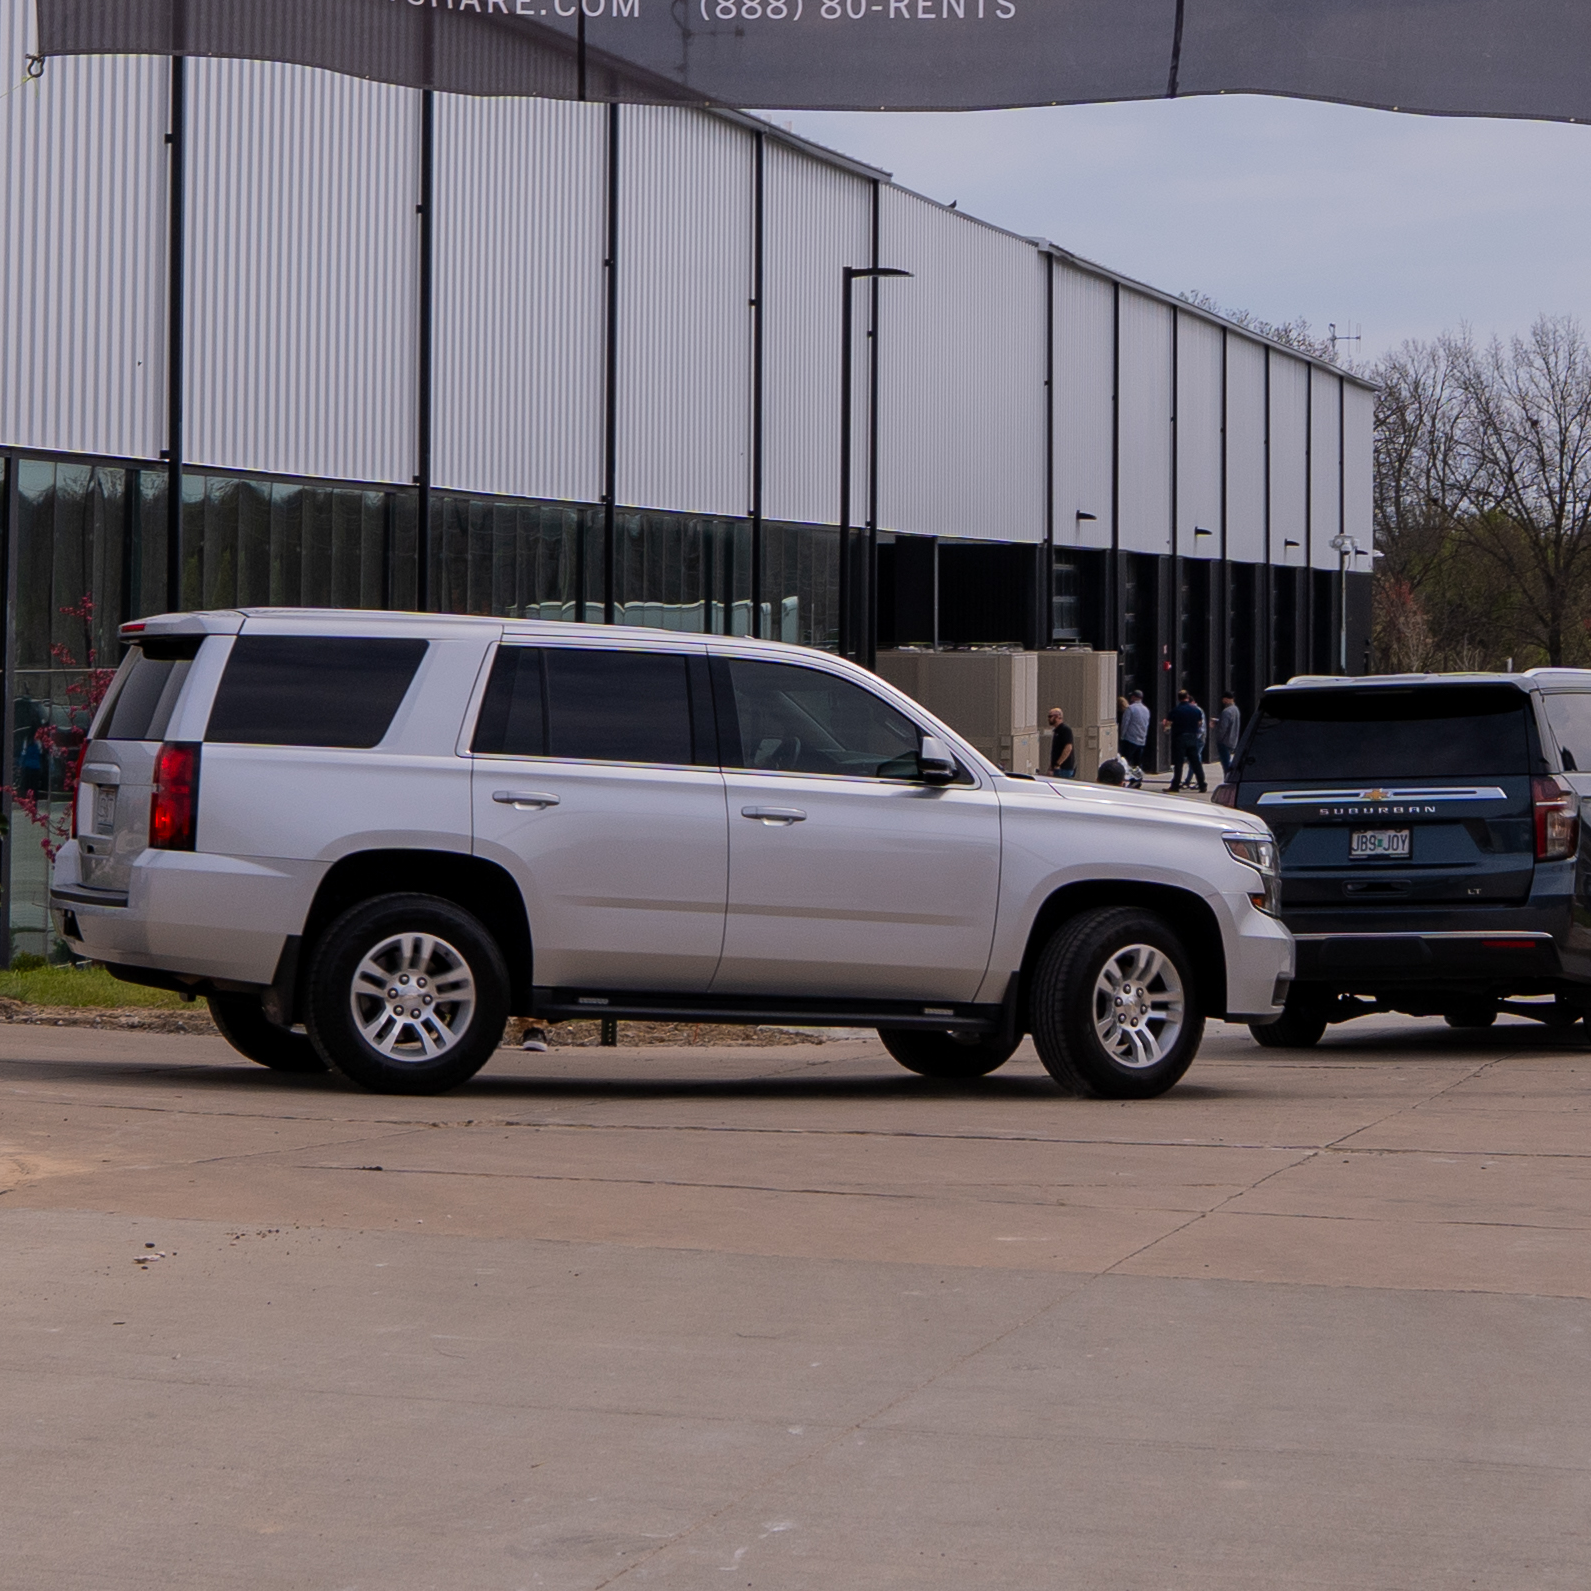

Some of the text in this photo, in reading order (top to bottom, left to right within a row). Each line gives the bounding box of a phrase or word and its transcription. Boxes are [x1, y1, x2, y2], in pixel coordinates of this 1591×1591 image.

[1319, 806, 1436, 816] SUBURBAN
[1352, 833, 1408, 852] JB9 JOY
